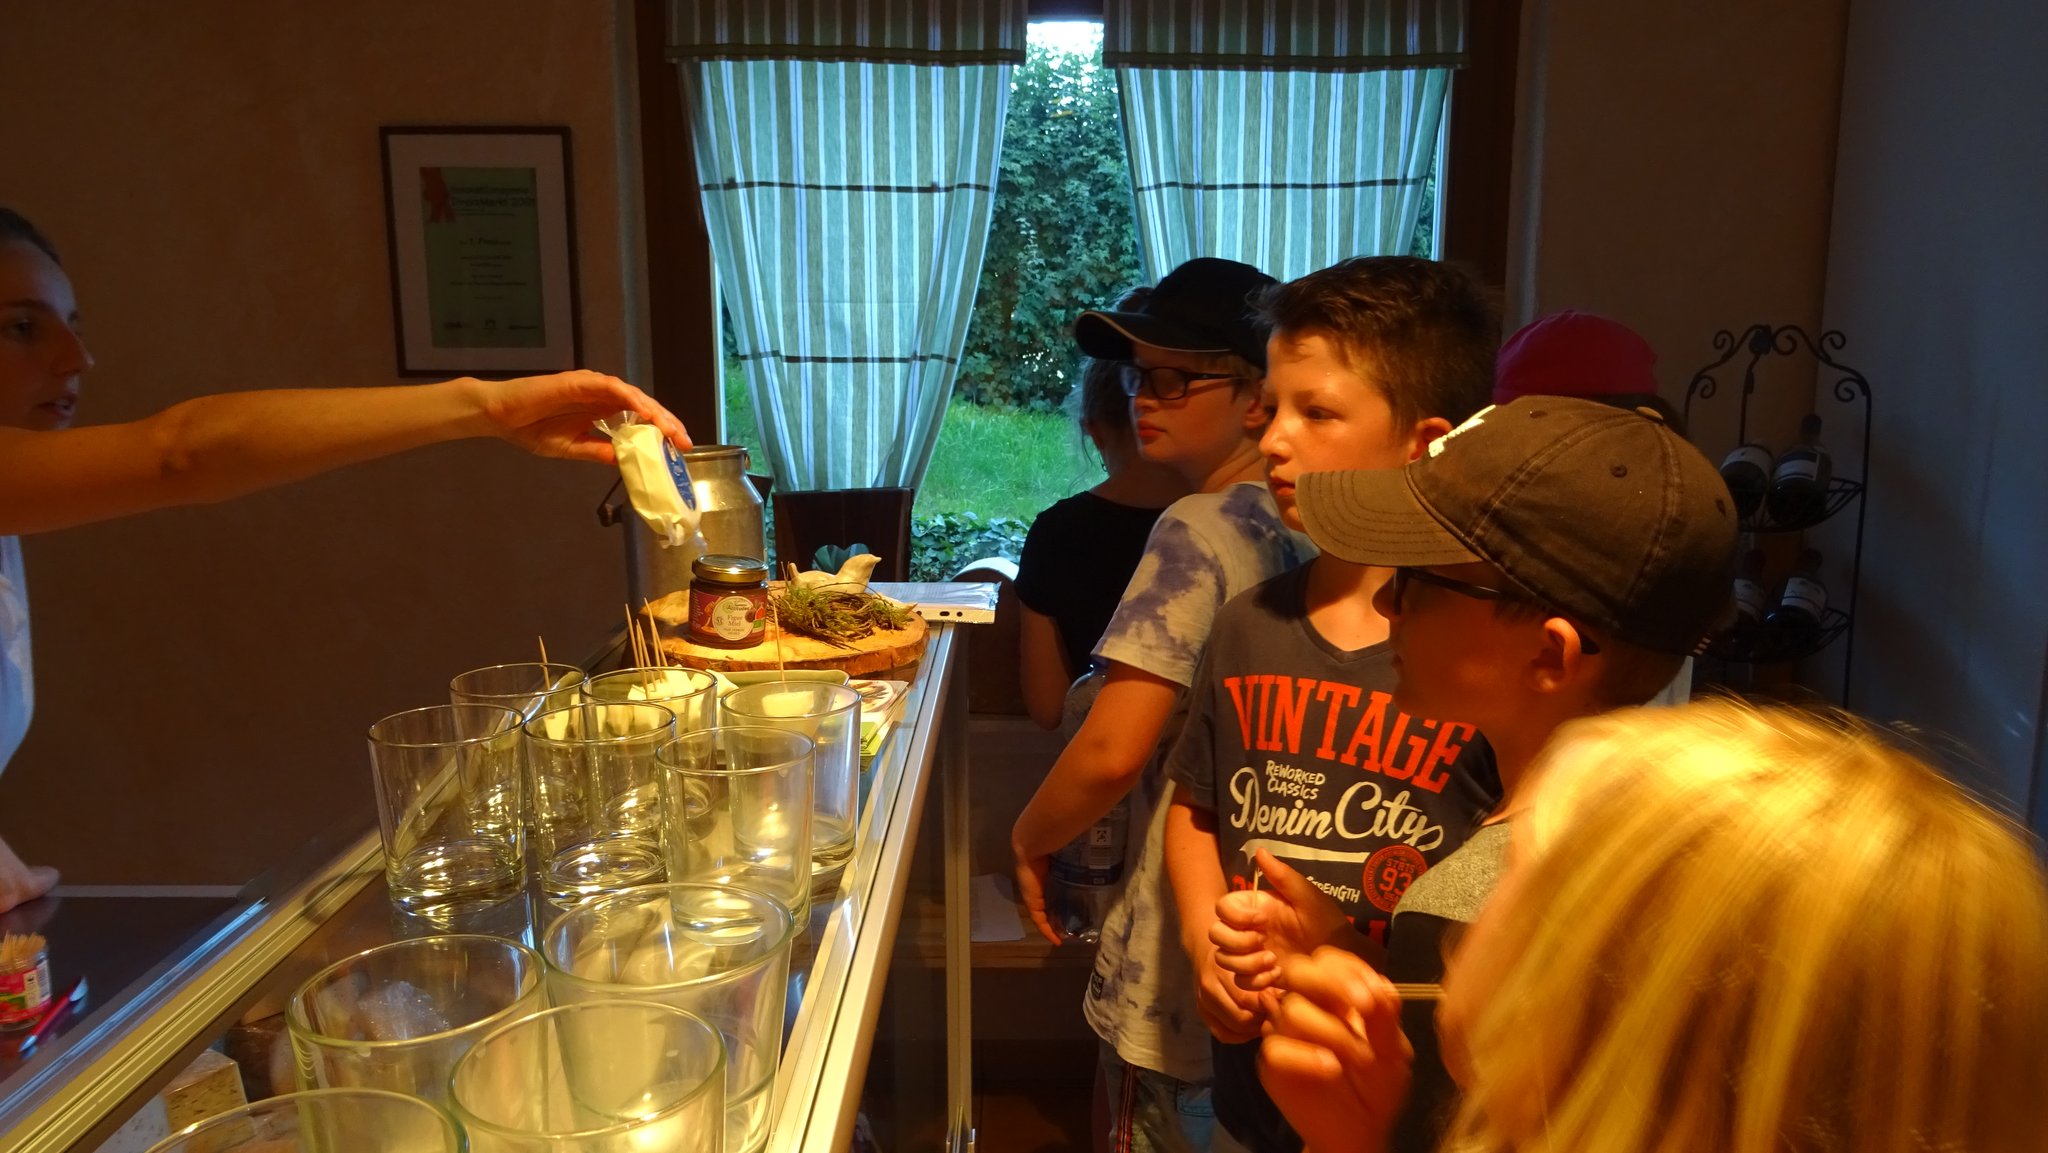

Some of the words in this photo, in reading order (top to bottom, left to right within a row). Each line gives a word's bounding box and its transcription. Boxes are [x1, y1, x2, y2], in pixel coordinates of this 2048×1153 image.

[1223, 674, 1478, 794] VINTAGE
[1265, 760, 1326, 786] REWORKED
[1267, 777, 1319, 800] CLASSICS
[1229, 766, 1333, 840] Denim
[1334, 781, 1444, 853] City
[1378, 867, 1412, 896] 93
